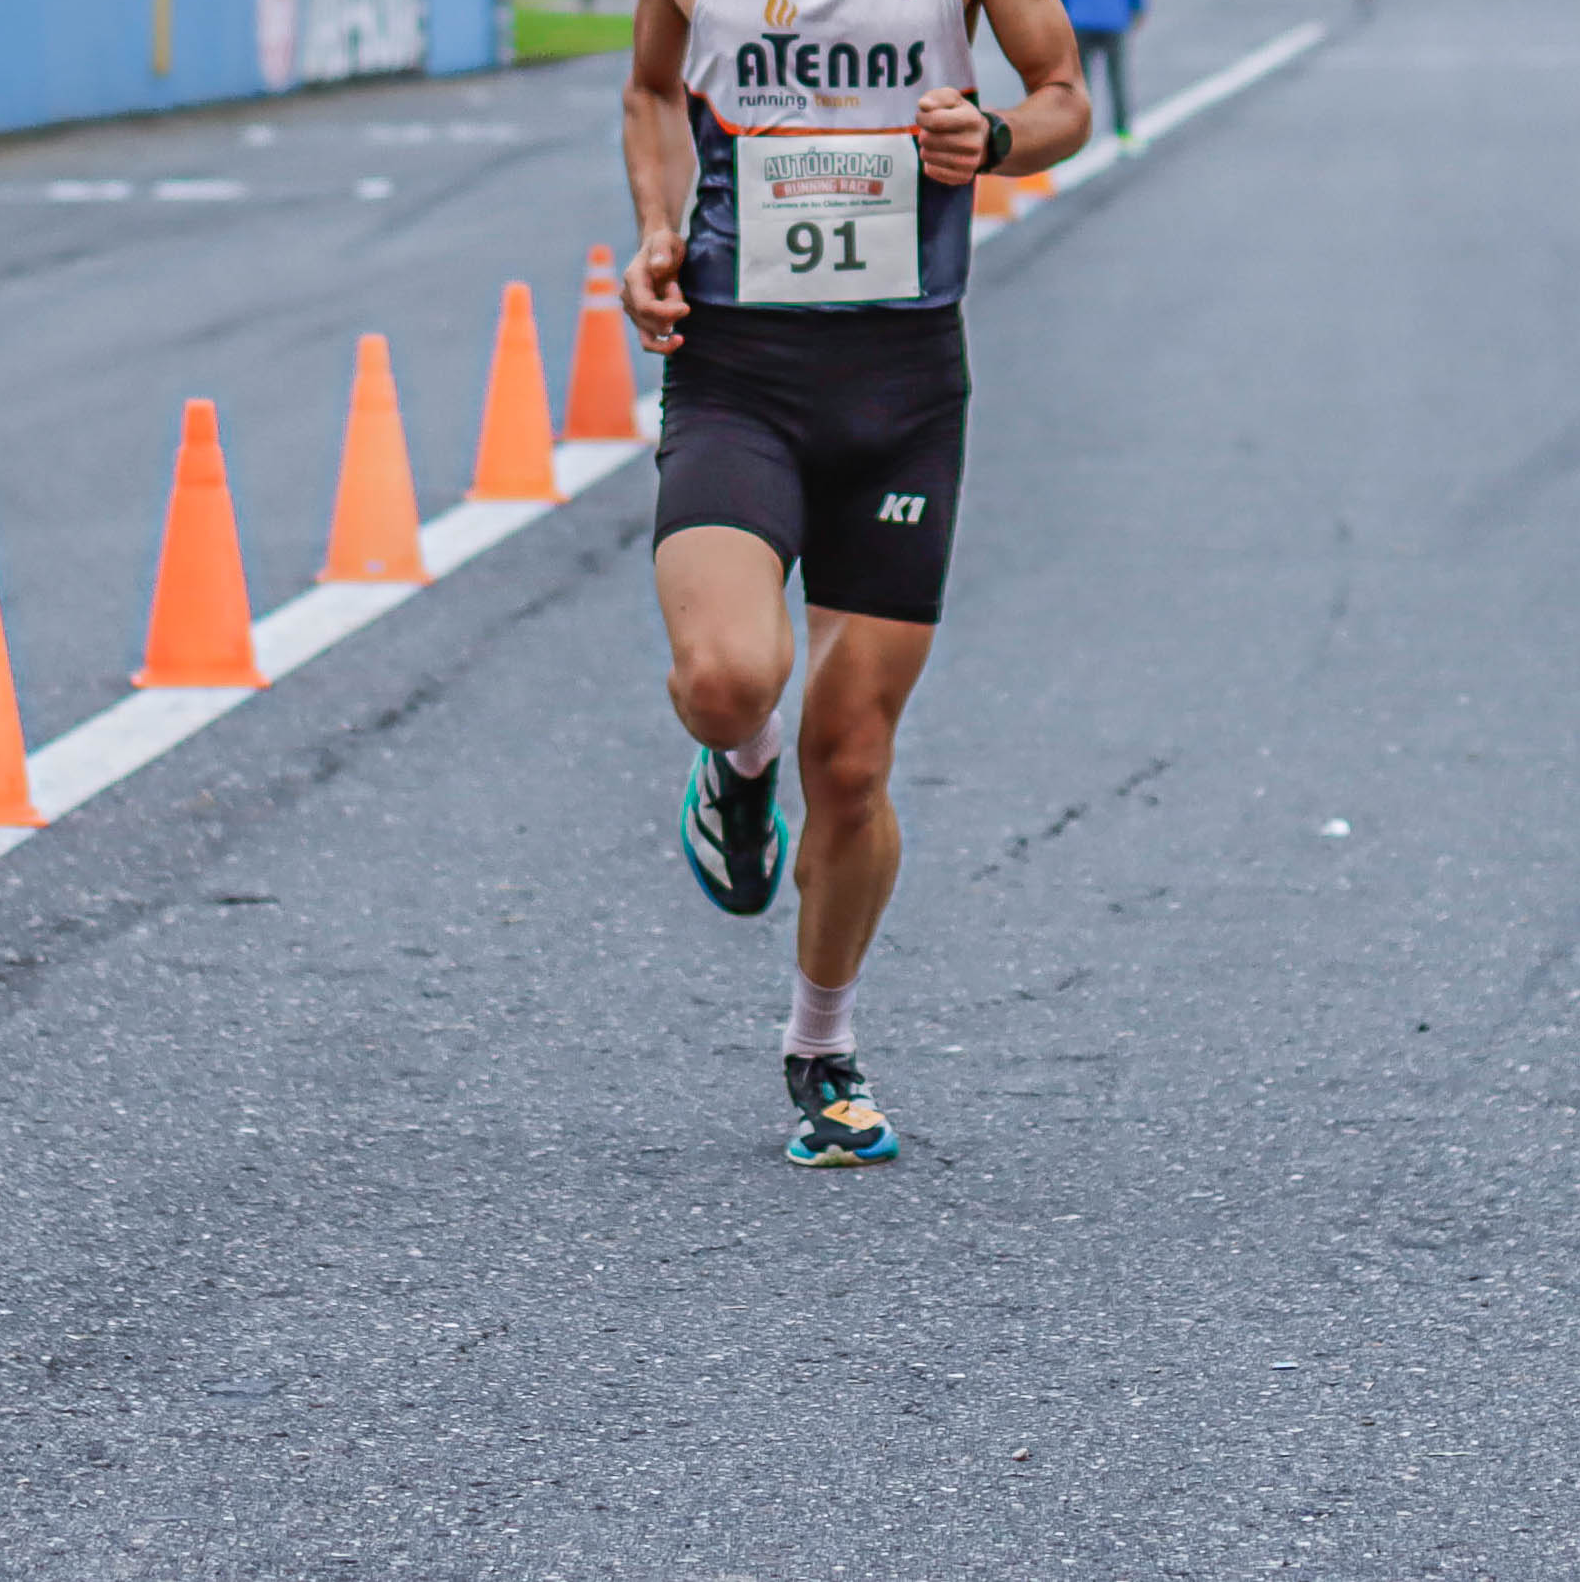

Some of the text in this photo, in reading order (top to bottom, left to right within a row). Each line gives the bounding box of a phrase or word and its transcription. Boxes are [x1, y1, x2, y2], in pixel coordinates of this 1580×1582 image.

[738, 93, 860, 109] running team
[764, 146, 893, 181] AUTÓDROMO
[783, 178, 838, 197] RUNNING
[786, 220, 867, 274] 91
